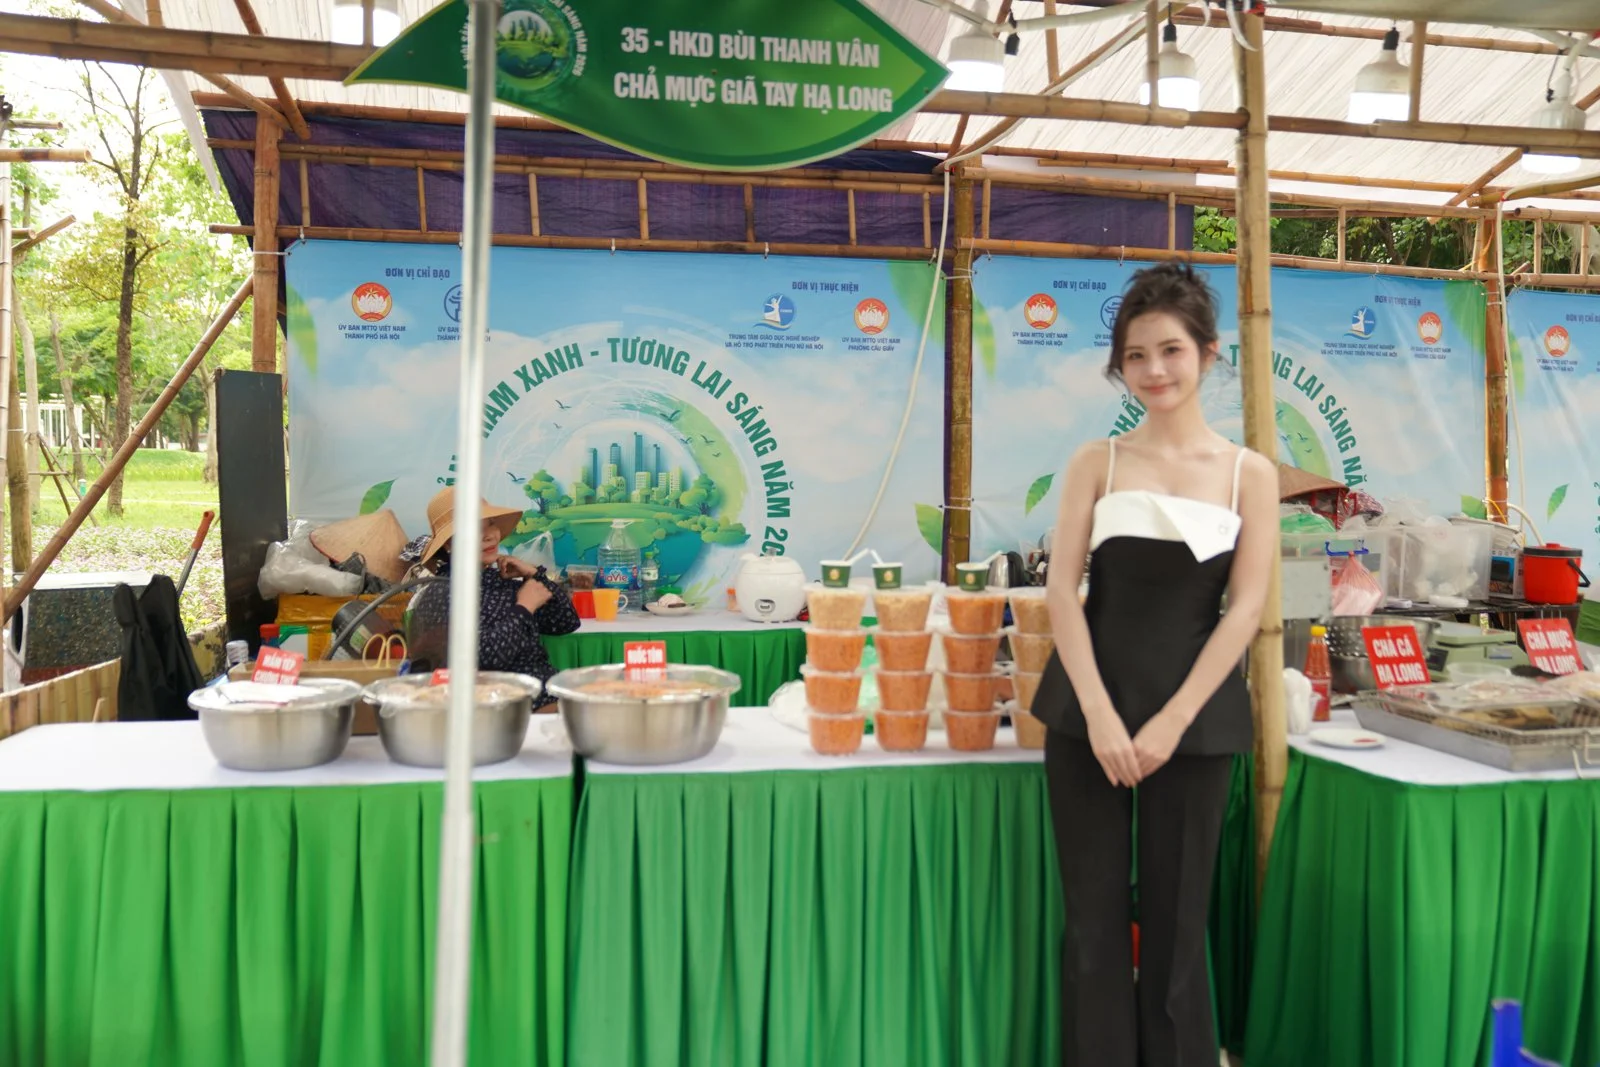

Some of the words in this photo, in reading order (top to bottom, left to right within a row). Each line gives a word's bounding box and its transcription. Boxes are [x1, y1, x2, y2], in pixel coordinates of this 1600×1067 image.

[621, 27, 649, 53] 35
[669, 30, 714, 58] HKD
[719, 30, 756, 61] BÙI
[760, 36, 832, 65] THANH
[836, 38, 880, 68] VÂN
[613, 65, 660, 99] CHẢ
[665, 74, 715, 107] MỰC
[721, 75, 759, 105] GIÃ
[762, 80, 798, 107] TAY
[803, 83, 832, 114] HẠ
[837, 85, 893, 112] LONG
[385, 267, 403, 278] ĐƠN
[405, 268, 415, 280] VỊ
[416, 266, 431, 278] CHỈ
[433, 269, 450, 280] ĐẠO
[1053, 280, 1068, 289] ĐƠN
[1069, 281, 1077, 291] VỊ
[1079, 279, 1090, 290] CHỈ
[1091, 281, 1107, 292] ĐẠO
[792, 281, 808, 291] ĐƠN
[810, 282, 818, 293] VỊ
[820, 282, 839, 294] THỰC
[841, 281, 859, 293] HIỆN
[513, 342, 584, 392] XANH
[607, 336, 691, 377] TƯƠNG
[691, 360, 733, 400] LAI
[726, 392, 778, 458] SÁNG
[760, 460, 794, 518] NĂM
[1293, 366, 1325, 401] LAI
[1318, 394, 1357, 454] SÁNG
[1342, 456, 1367, 487] NĂ
[1372, 630, 1399, 658] CHẢ
[1396, 634, 1416, 657] CÁ
[1526, 624, 1550, 650] CHẢ
[1545, 629, 1572, 652] MỰC
[1375, 664, 1396, 689] HẠ
[1392, 662, 1426, 683] LONG
[1549, 654, 1579, 674] LONG
